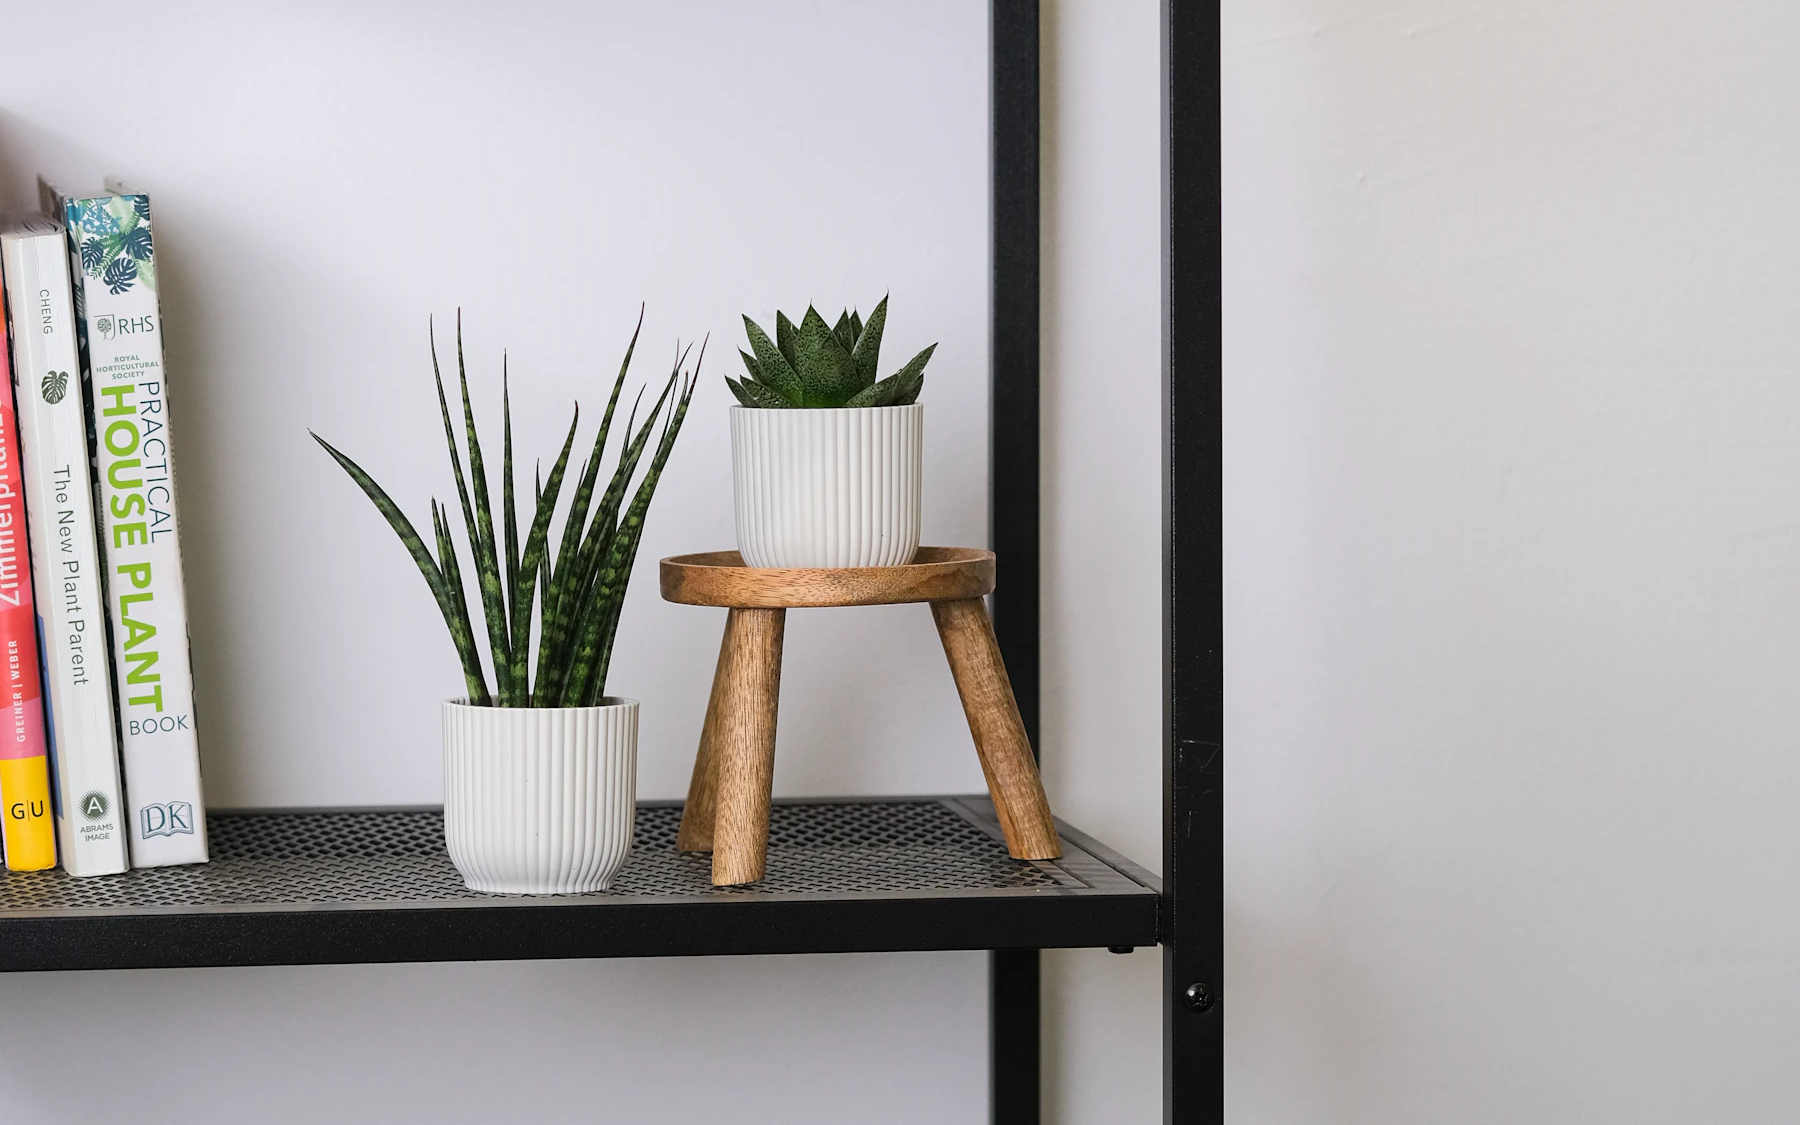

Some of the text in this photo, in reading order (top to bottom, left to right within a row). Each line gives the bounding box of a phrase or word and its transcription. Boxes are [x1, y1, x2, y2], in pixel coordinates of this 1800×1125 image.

[39, 289, 54, 335] CHENG
[118, 315, 155, 335] RHS
[96, 361, 160, 374] HORTICULTURAL
[114, 354, 141, 363] ROYAL
[112, 370, 145, 380] SOCIETY
[138, 381, 173, 544] PRACTICAL
[101, 384, 164, 713] HOUSE PLANT
[53, 464, 89, 686] The New Plant Parent
[8, 639, 21, 681] WEBER
[13, 692, 26, 743] GREINER
[129, 714, 189, 736] BOOK
[80, 823, 114, 834] ABRAMS
[145, 804, 188, 833] DK
[85, 832, 110, 842] IMAGE
